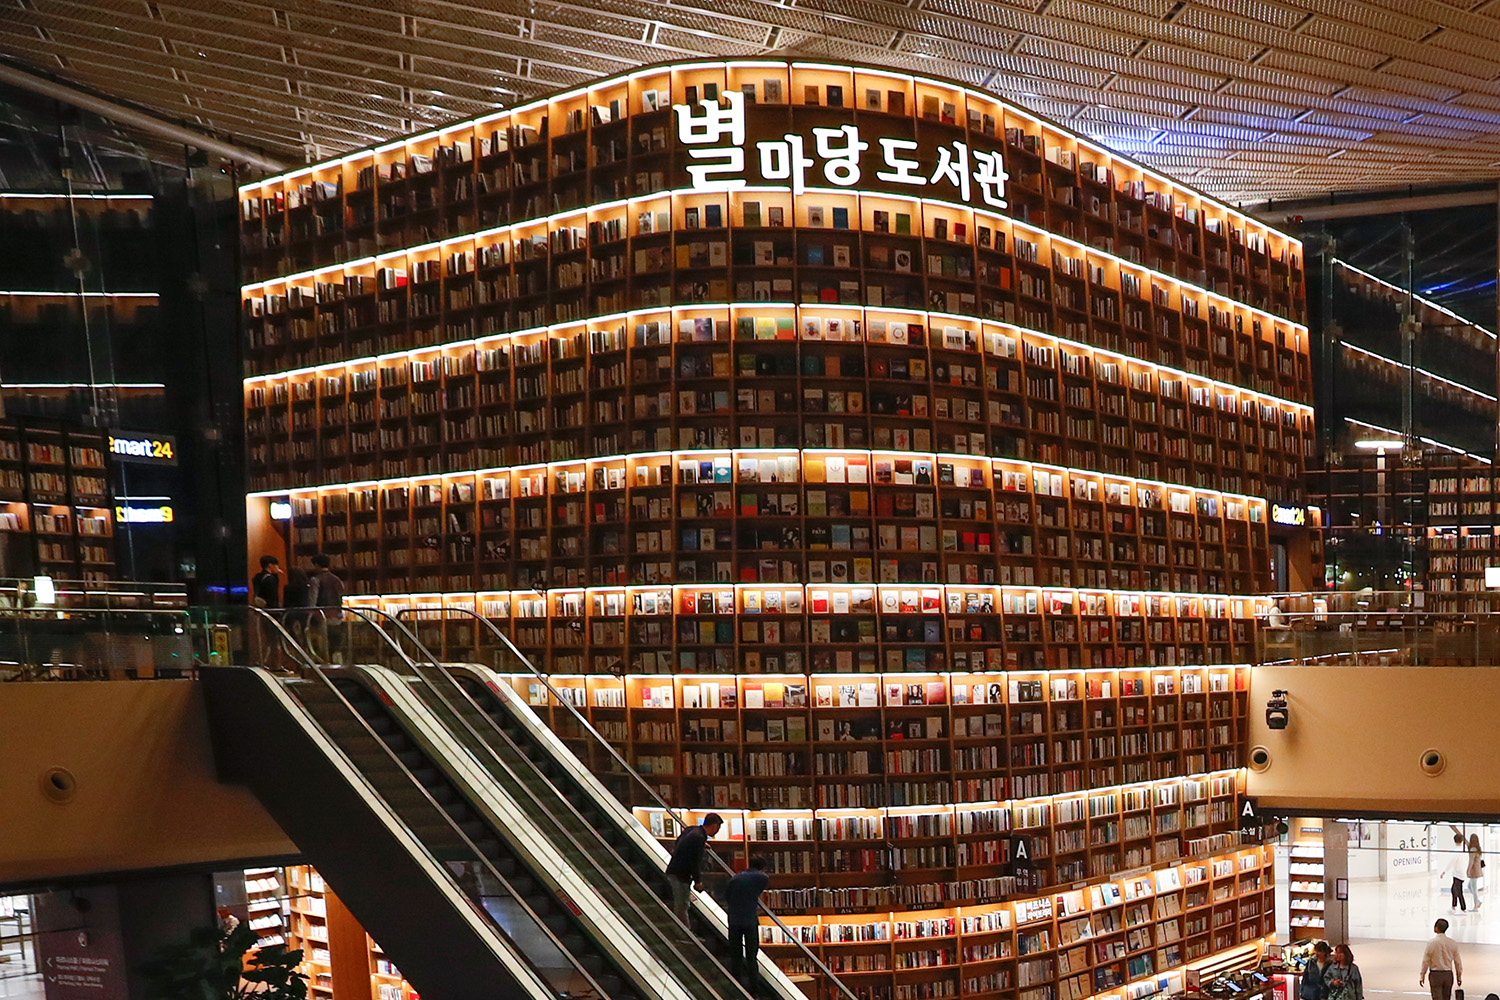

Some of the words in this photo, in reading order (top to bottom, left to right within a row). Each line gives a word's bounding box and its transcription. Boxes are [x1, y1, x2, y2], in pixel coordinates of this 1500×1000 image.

[1242, 801, 1255, 817] A
[1016, 840, 1028, 859] A
[1393, 856, 1422, 867] OPENING
